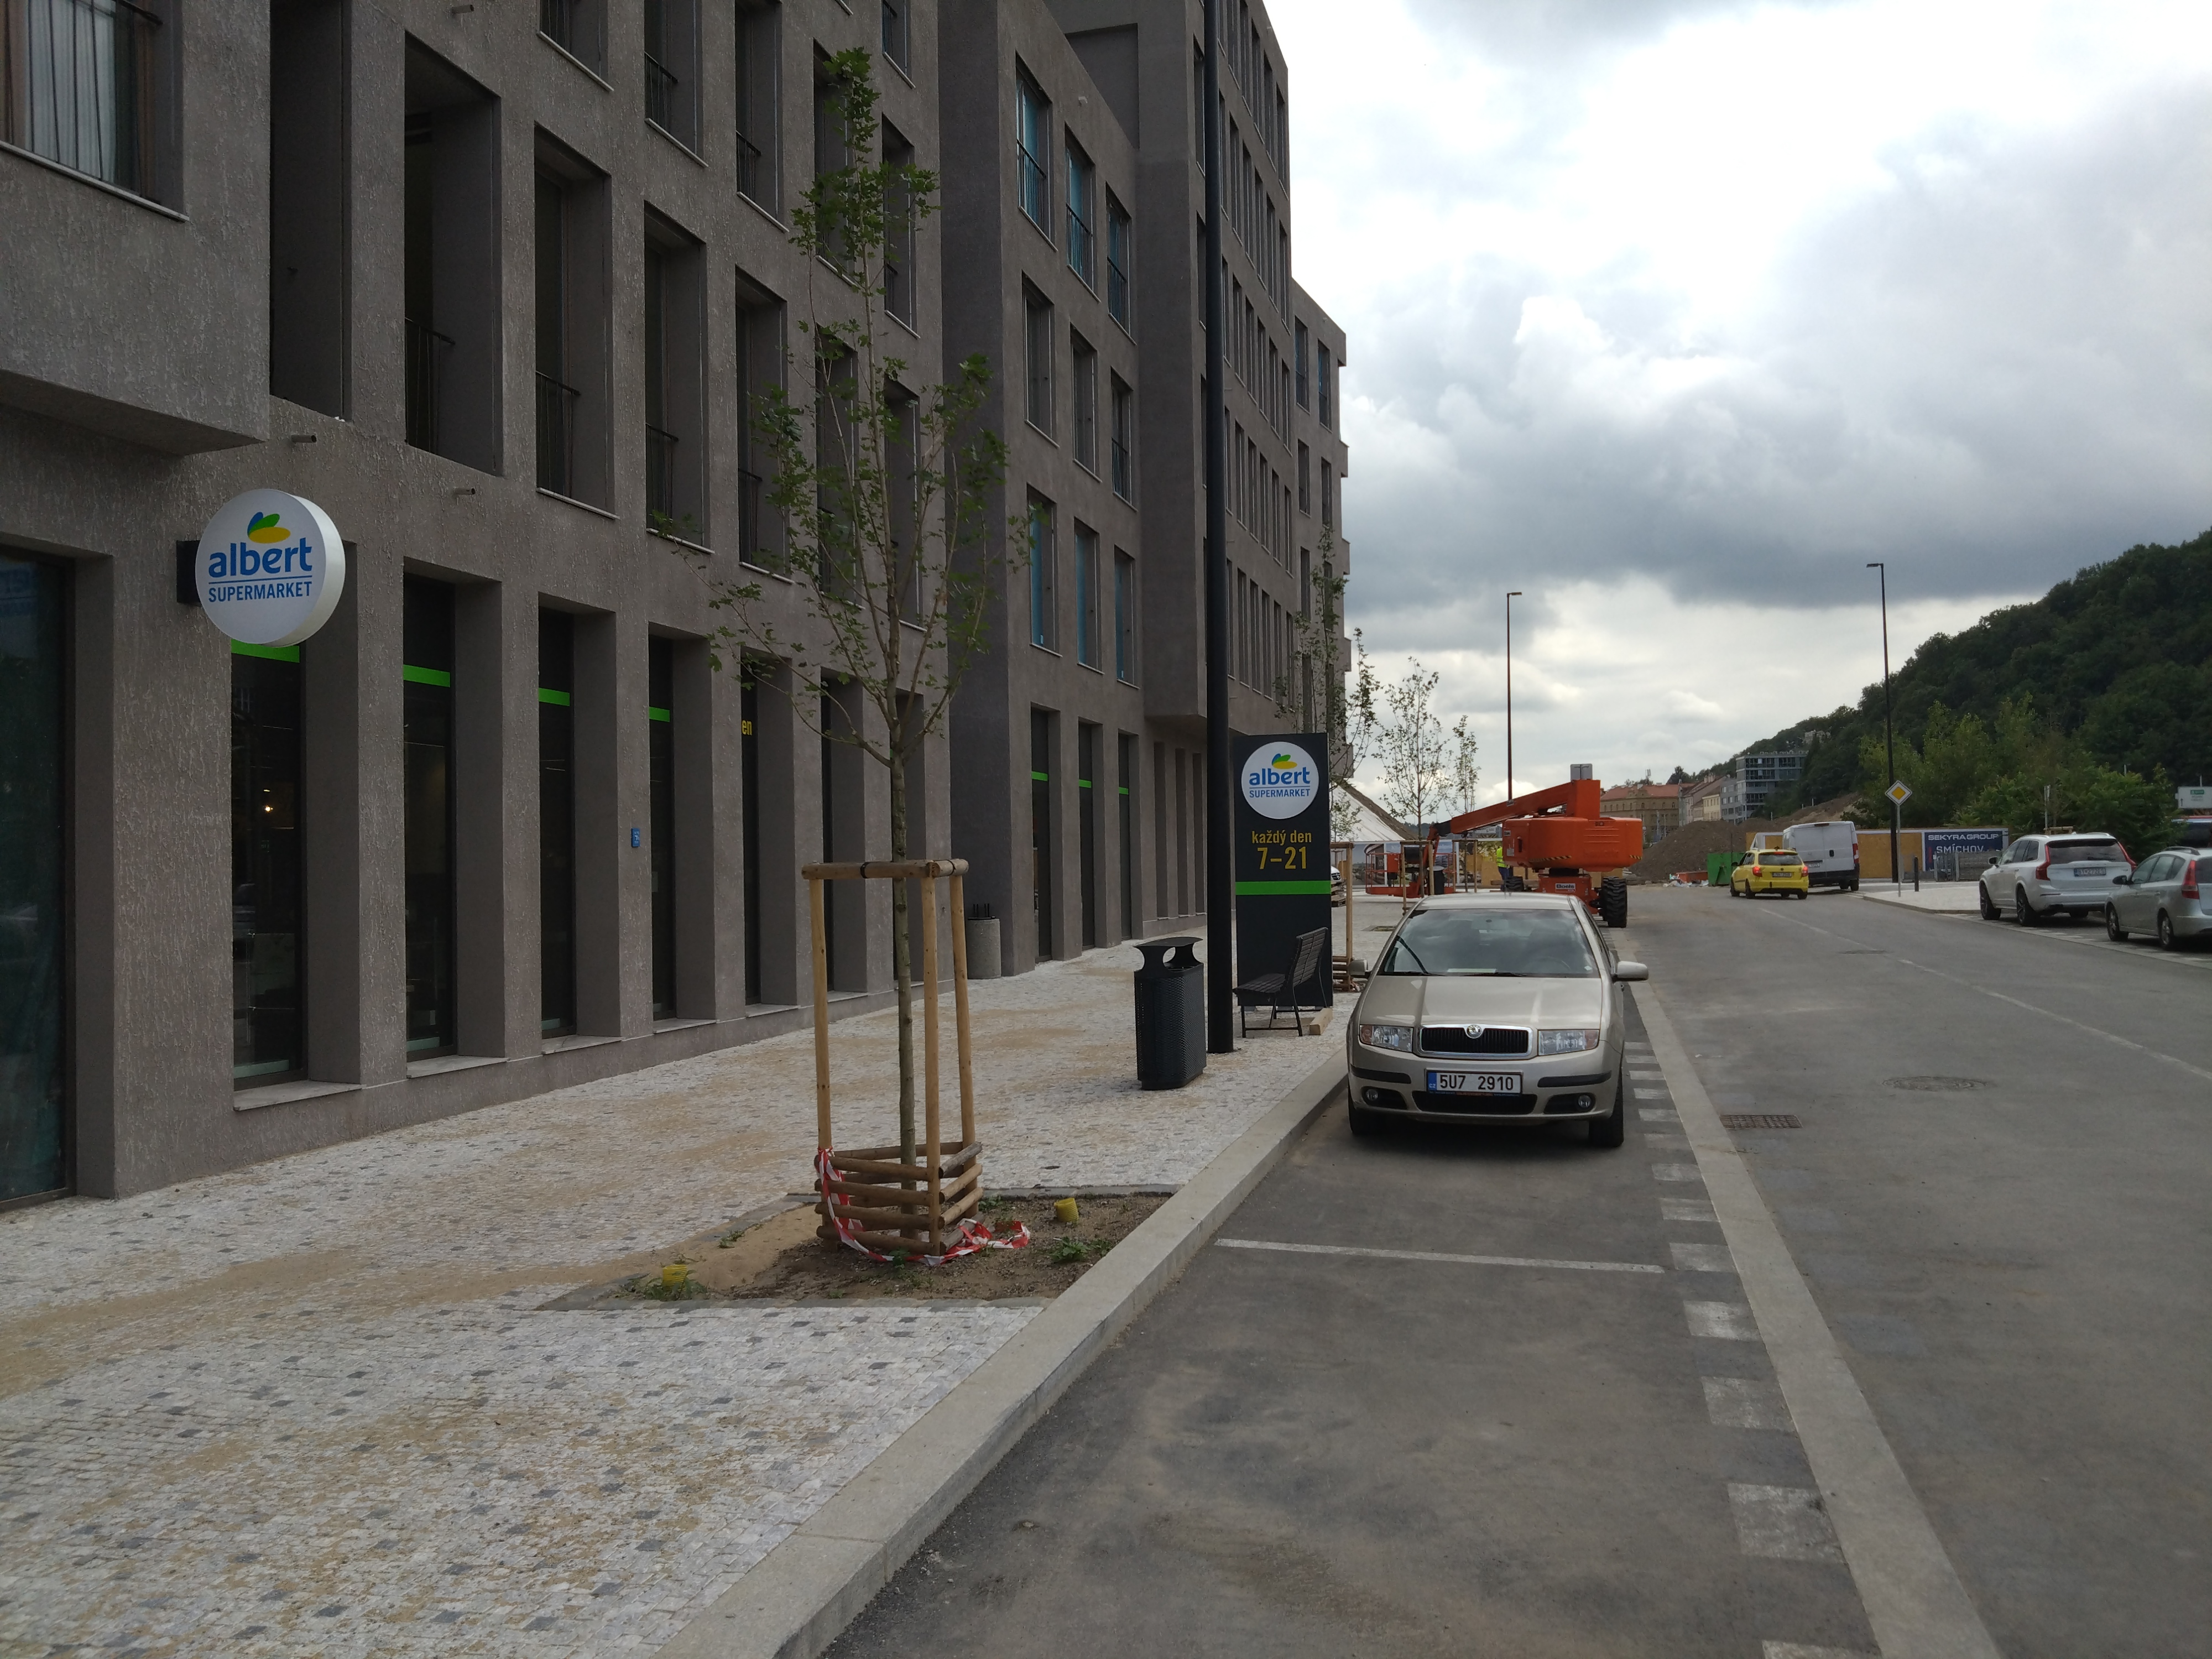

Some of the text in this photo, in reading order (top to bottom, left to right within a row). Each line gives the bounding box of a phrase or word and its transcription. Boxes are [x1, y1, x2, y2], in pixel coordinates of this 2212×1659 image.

[208, 538, 312, 578] albert
[208, 581, 312, 602] SUPERMARKET
[1249, 766, 1311, 786] albert
[1249, 789, 1311, 798] SUPERMARKET
[1251, 830, 1312, 846] každý den
[1936, 843, 1984, 854] SMÍCHOV
[1439, 1074, 1514, 1091] 5U7 2910
